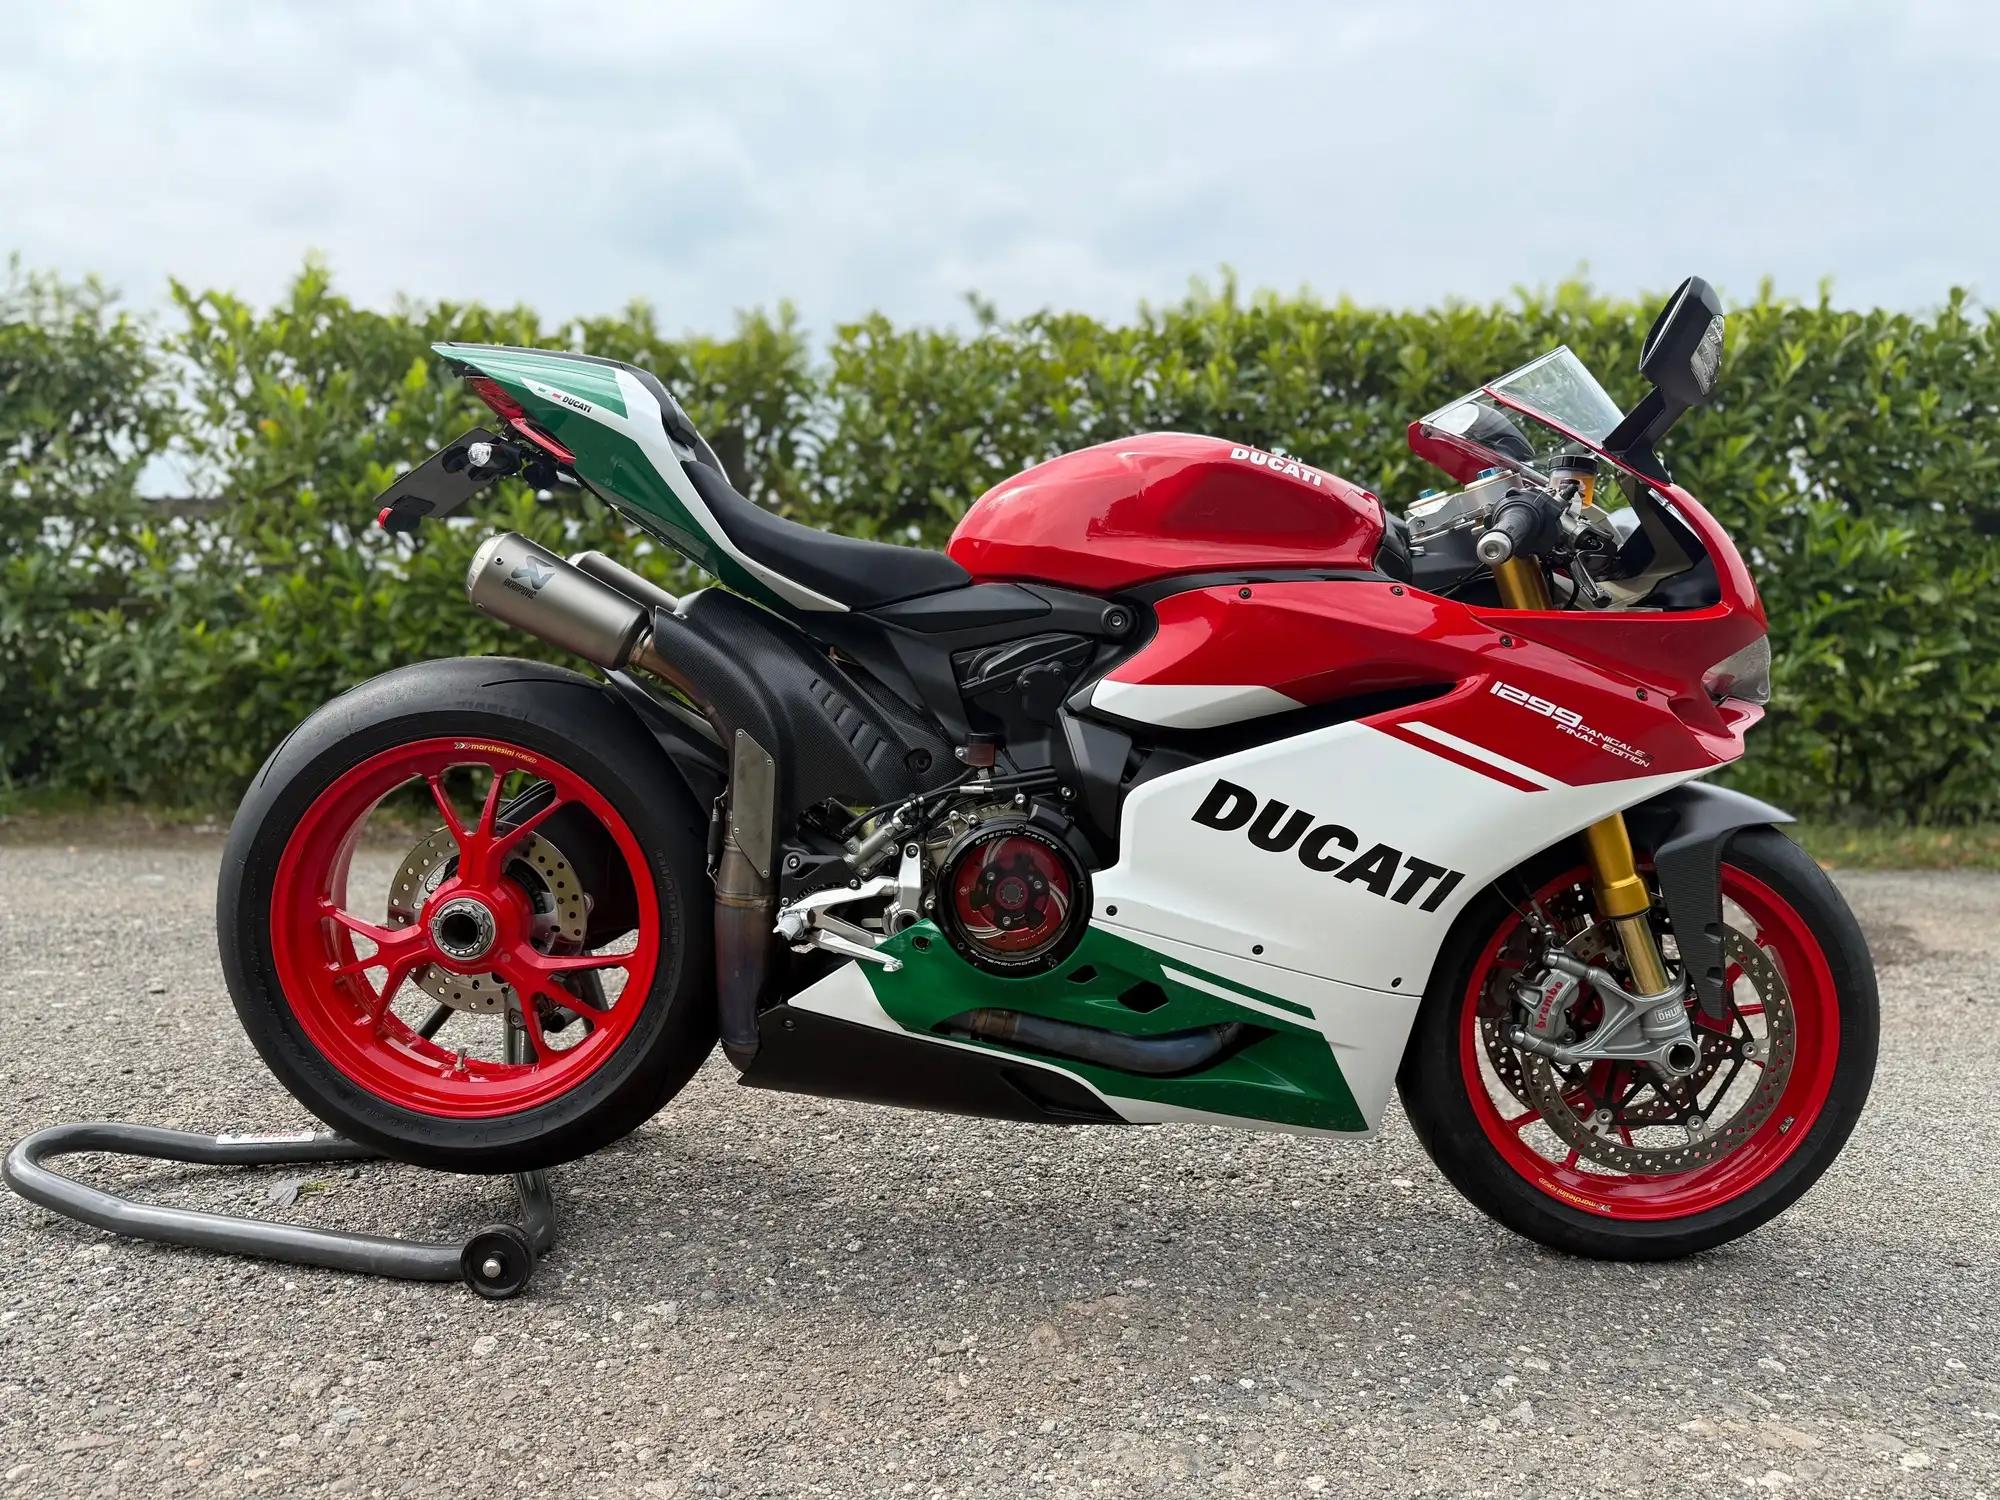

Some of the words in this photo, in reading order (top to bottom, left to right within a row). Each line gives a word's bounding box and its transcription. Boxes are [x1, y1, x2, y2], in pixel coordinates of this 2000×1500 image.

[562, 396, 592, 413] DUCATI
[1230, 447, 1322, 487] DUCATI
[1489, 680, 1584, 728] 1299
[1577, 724, 1645, 758] PANIGALE
[471, 742, 515, 757] marchesini
[515, 751, 538, 764] FORGED
[1556, 723, 1599, 746] FINAL
[1601, 743, 1651, 768] EDITION
[975, 830, 1019, 846] SPECIAL
[1023, 831, 1058, 850] PARTS
[1190, 778, 1466, 913] DUCATI
[1535, 981, 1564, 1029] brembo
[1557, 1188, 1597, 1207] marchesini
